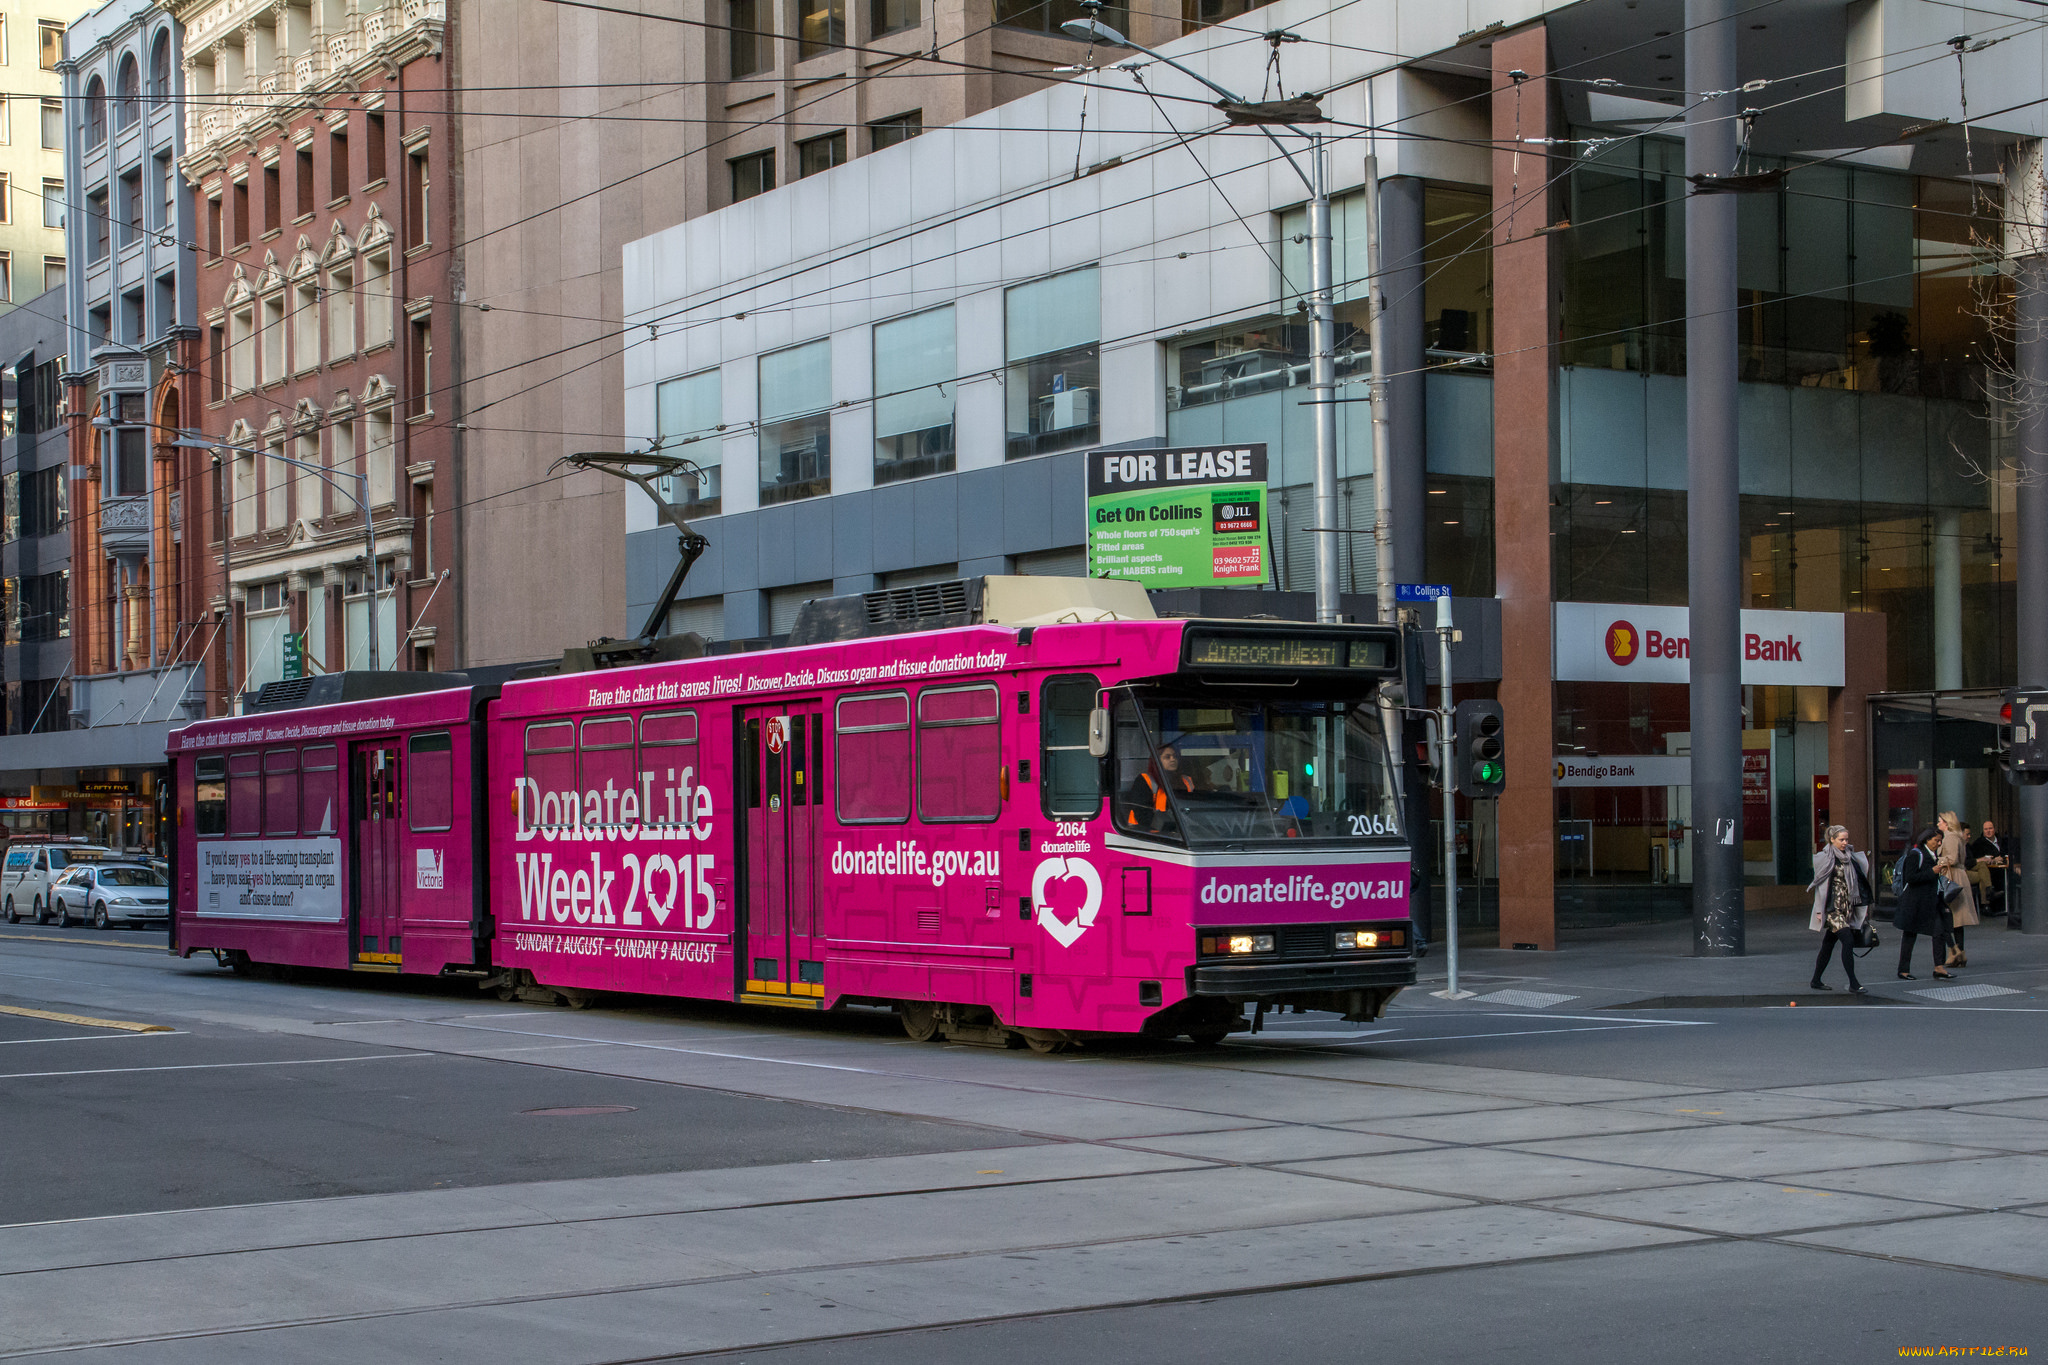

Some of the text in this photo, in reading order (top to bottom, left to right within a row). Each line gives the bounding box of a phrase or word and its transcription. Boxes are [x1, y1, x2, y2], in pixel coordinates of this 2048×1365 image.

[1103, 450, 1252, 483] FOR LEASE
[1096, 504, 1203, 524] Get On Collins
[1234, 506, 1252, 516] JLL
[1096, 530, 1122, 539] Whole
[1123, 530, 1148, 538] floors
[1149, 528, 1158, 538] of
[1096, 542, 1120, 551] Fitted
[1096, 554, 1162, 564] Brilliant aspects
[1243, 555, 1260, 563] 5722
[1123, 566, 1156, 575] NABERS
[1158, 565, 1183, 574] rating
[1214, 564, 1259, 573] Knight Frank
[1414, 585, 1450, 596] Collins St
[1744, 633, 1802, 662] Bank
[588, 648, 1008, 707] Have the chat that saves lives! Discover, Decide, Discuss organ and tissue donation today
[181, 735, 195, 748] Have
[196, 733, 205, 746] the
[205, 731, 218, 746] chat
[218, 730, 230, 744] that
[230, 731, 246, 743] saves
[247, 727, 264, 742] lives!
[301, 725, 318, 737] Discuss
[318, 724, 332, 737] organ
[332, 722, 342, 733] and
[342, 720, 356, 732] tissue
[357, 718, 379, 731] donation
[379, 716, 395, 731] today
[769, 722, 782, 733] STOP
[1568, 765, 1635, 778] Bendigo Bank
[515, 766, 713, 842] DonateLife
[1056, 822, 1087, 836] 2064
[1347, 814, 1398, 836] 2064
[1041, 840, 1091, 853] donatelife
[205, 849, 334, 868] If you'd say yes to a life-saving transplant
[831, 840, 1000, 887] donatelife.gov.au
[226, 873, 238, 888] you
[252, 874, 264, 888] yes
[264, 872, 271, 885] to
[272, 871, 303, 888] becoming
[304, 874, 314, 886] an
[315, 873, 335, 889] organ
[418, 872, 443, 887] Victoria
[239, 891, 294, 906] and tissue donor?
[515, 852, 716, 930] Week 2015
[1200, 875, 1404, 909] donatelife.gov.au
[515, 933, 554, 952] SUNDAY
[556, 935, 562, 953] 2
[563, 935, 605, 956] AUGUST
[614, 938, 660, 960] SUNDAY
[661, 941, 668, 960] 9
[670, 942, 718, 963] AUGUST
